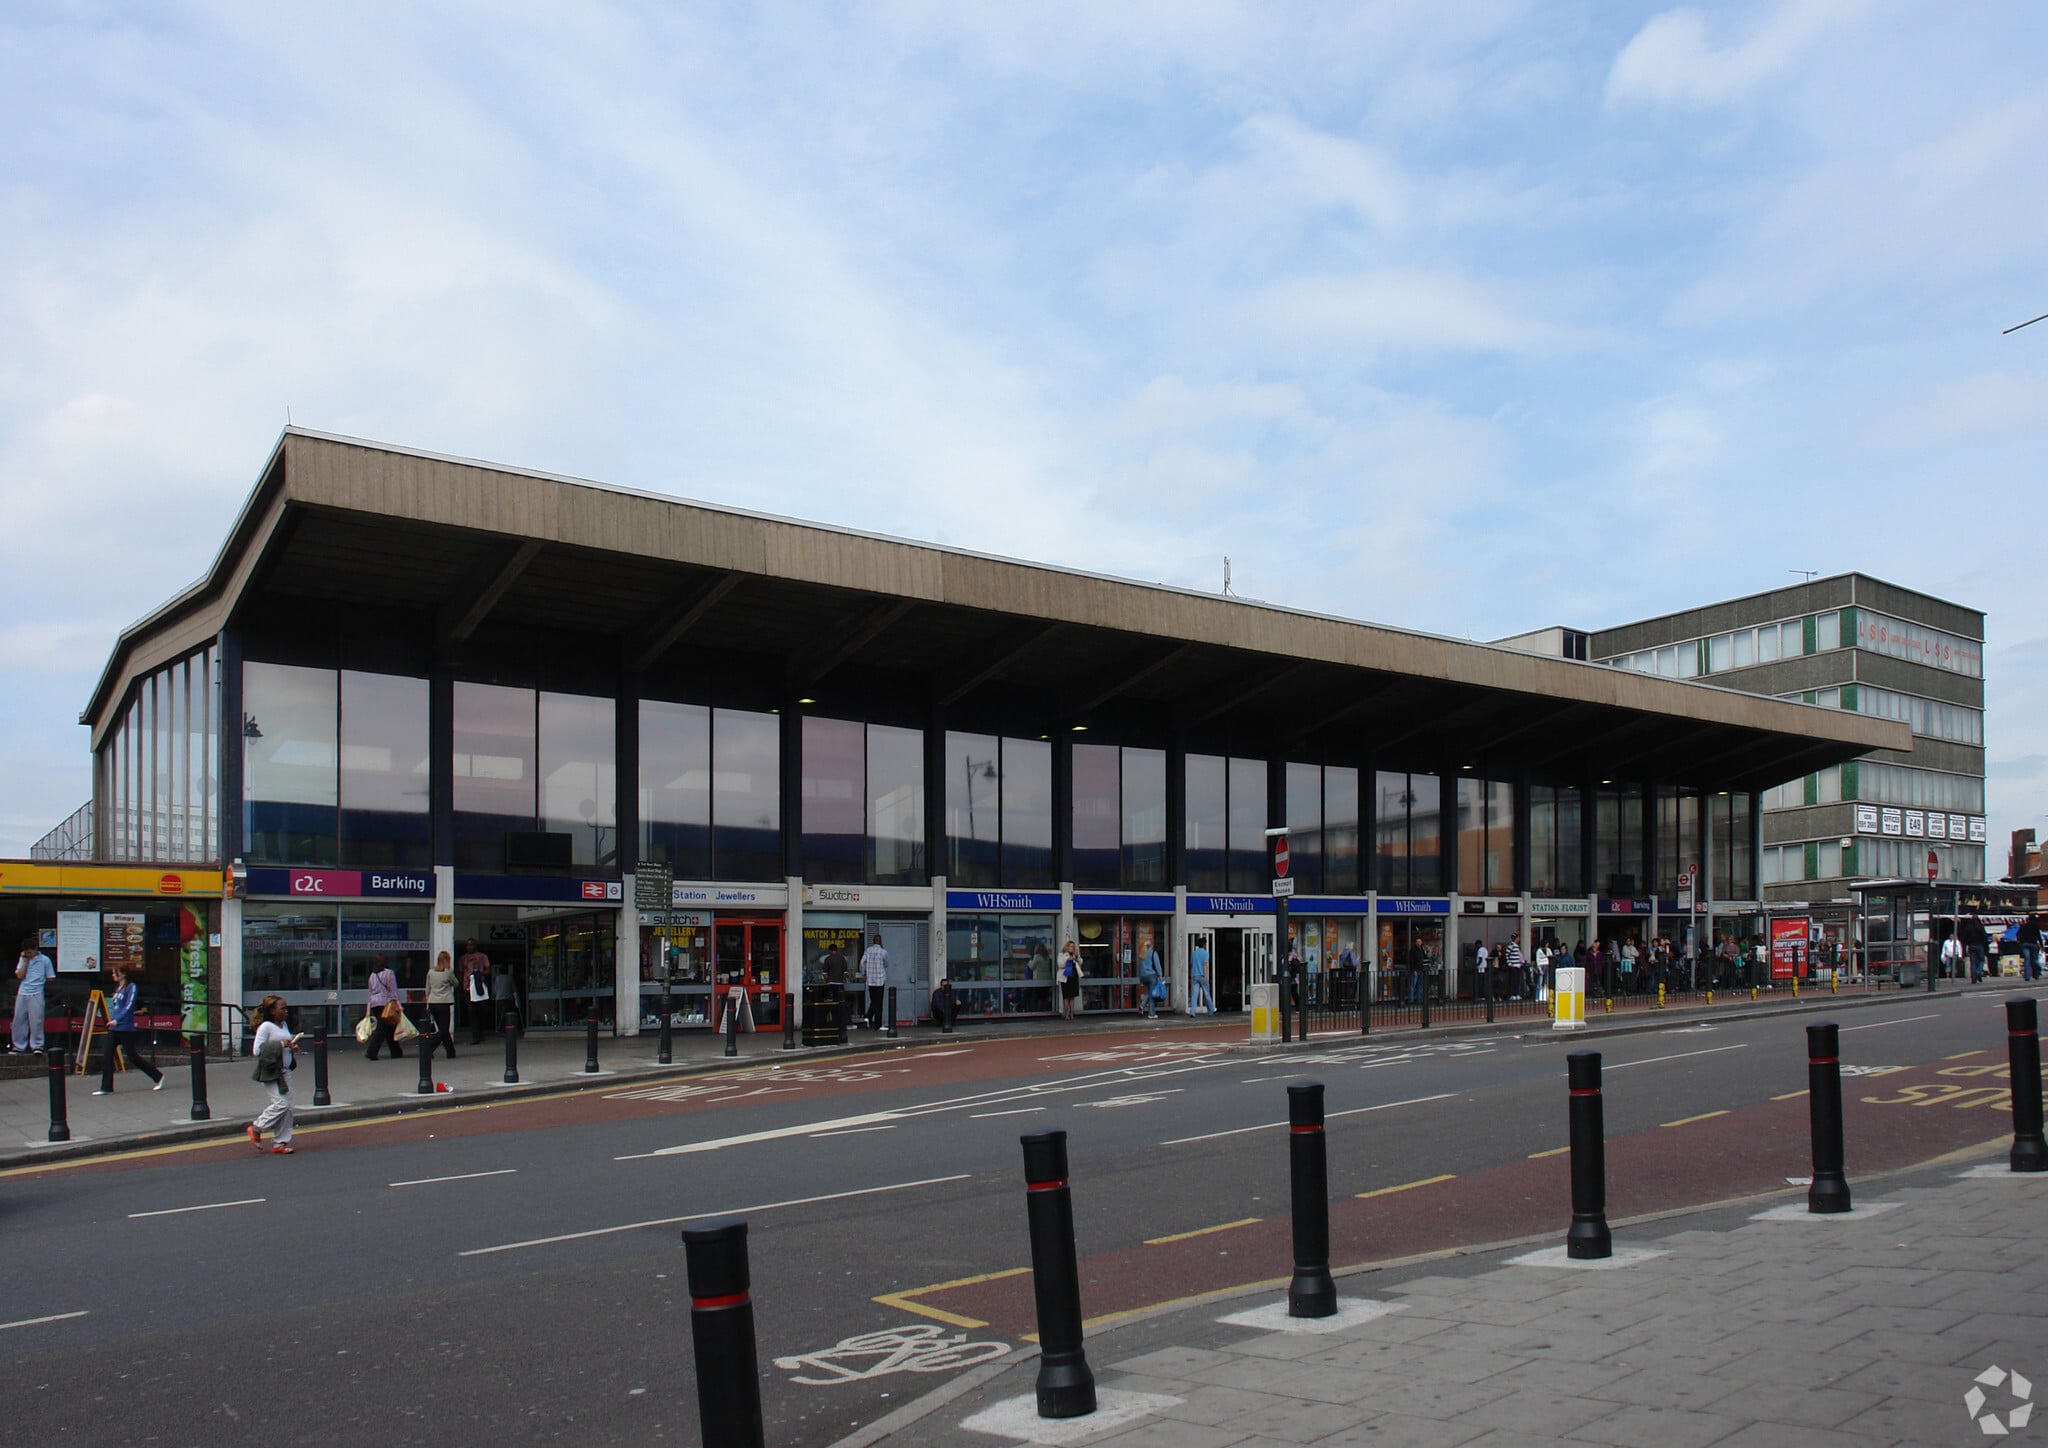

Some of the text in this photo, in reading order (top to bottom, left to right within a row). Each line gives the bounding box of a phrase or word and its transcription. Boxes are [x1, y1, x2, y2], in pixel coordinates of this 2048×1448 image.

[295, 875, 323, 892] c2c
[372, 876, 425, 892] Barking
[1274, 879, 1292, 888] Except
[673, 889, 756, 901] Station Jewellers
[977, 893, 1032, 909] WHSmith
[1210, 897, 1254, 911] WHSmith
[1395, 900, 1431, 912] WHSmith
[1532, 903, 1588, 912] STATION FLORIST
[804, 929, 829, 939] WATCH
[838, 930, 860, 939] CLOCK
[189, 940, 203, 978] fresh
[181, 983, 195, 1017] tasty
[601, 1084, 806, 1103] ONLY
